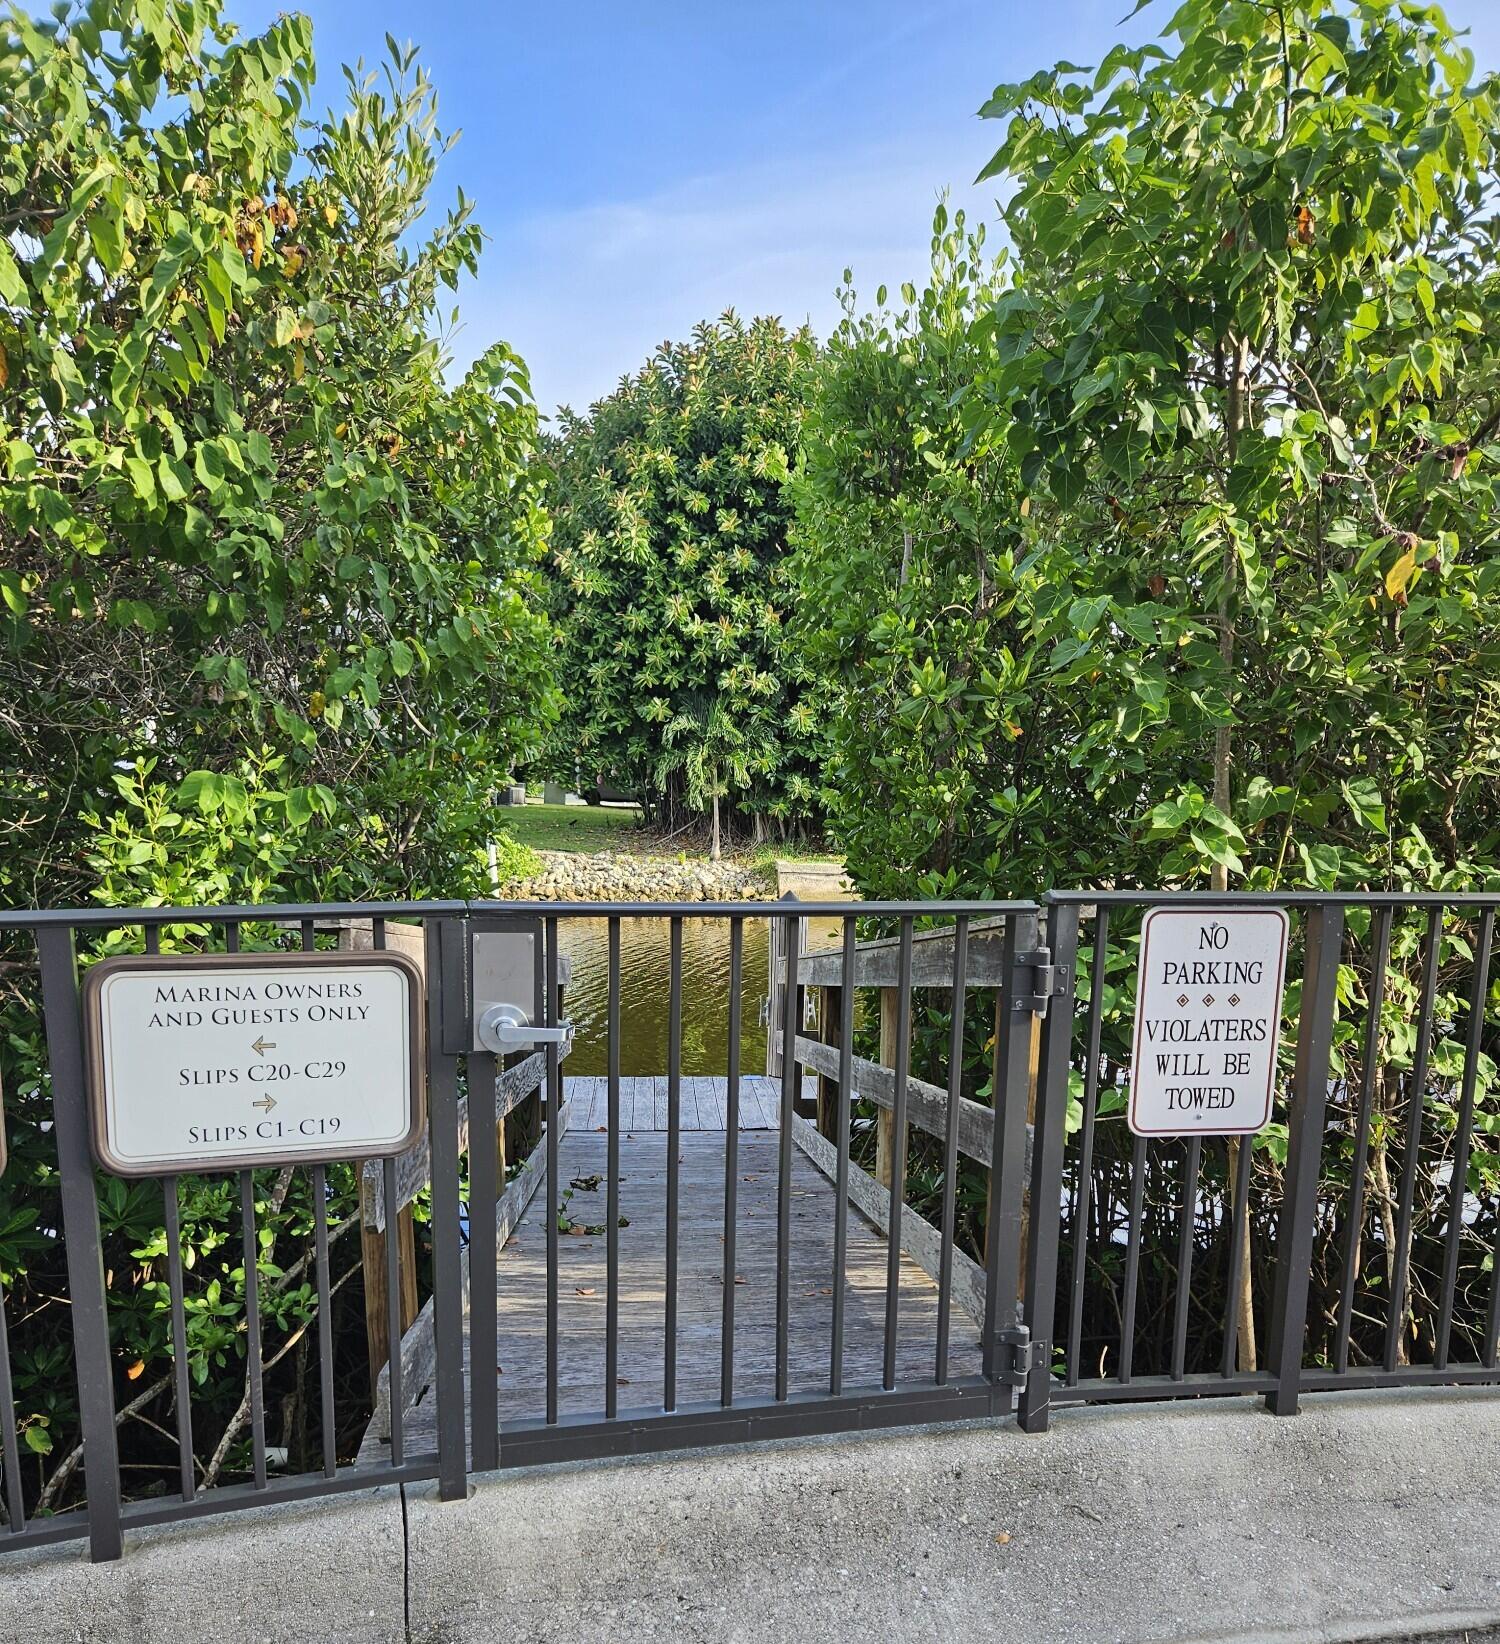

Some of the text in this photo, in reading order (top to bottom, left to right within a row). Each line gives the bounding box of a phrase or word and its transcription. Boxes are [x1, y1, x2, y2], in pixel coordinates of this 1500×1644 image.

[1199, 926, 1229, 950] NO
[1161, 961, 1263, 985] PARKING
[1145, 1018, 1267, 1042] VIOLATERS
[1156, 1053, 1251, 1077] WILL BE
[1165, 1087, 1235, 1110] TOWED
